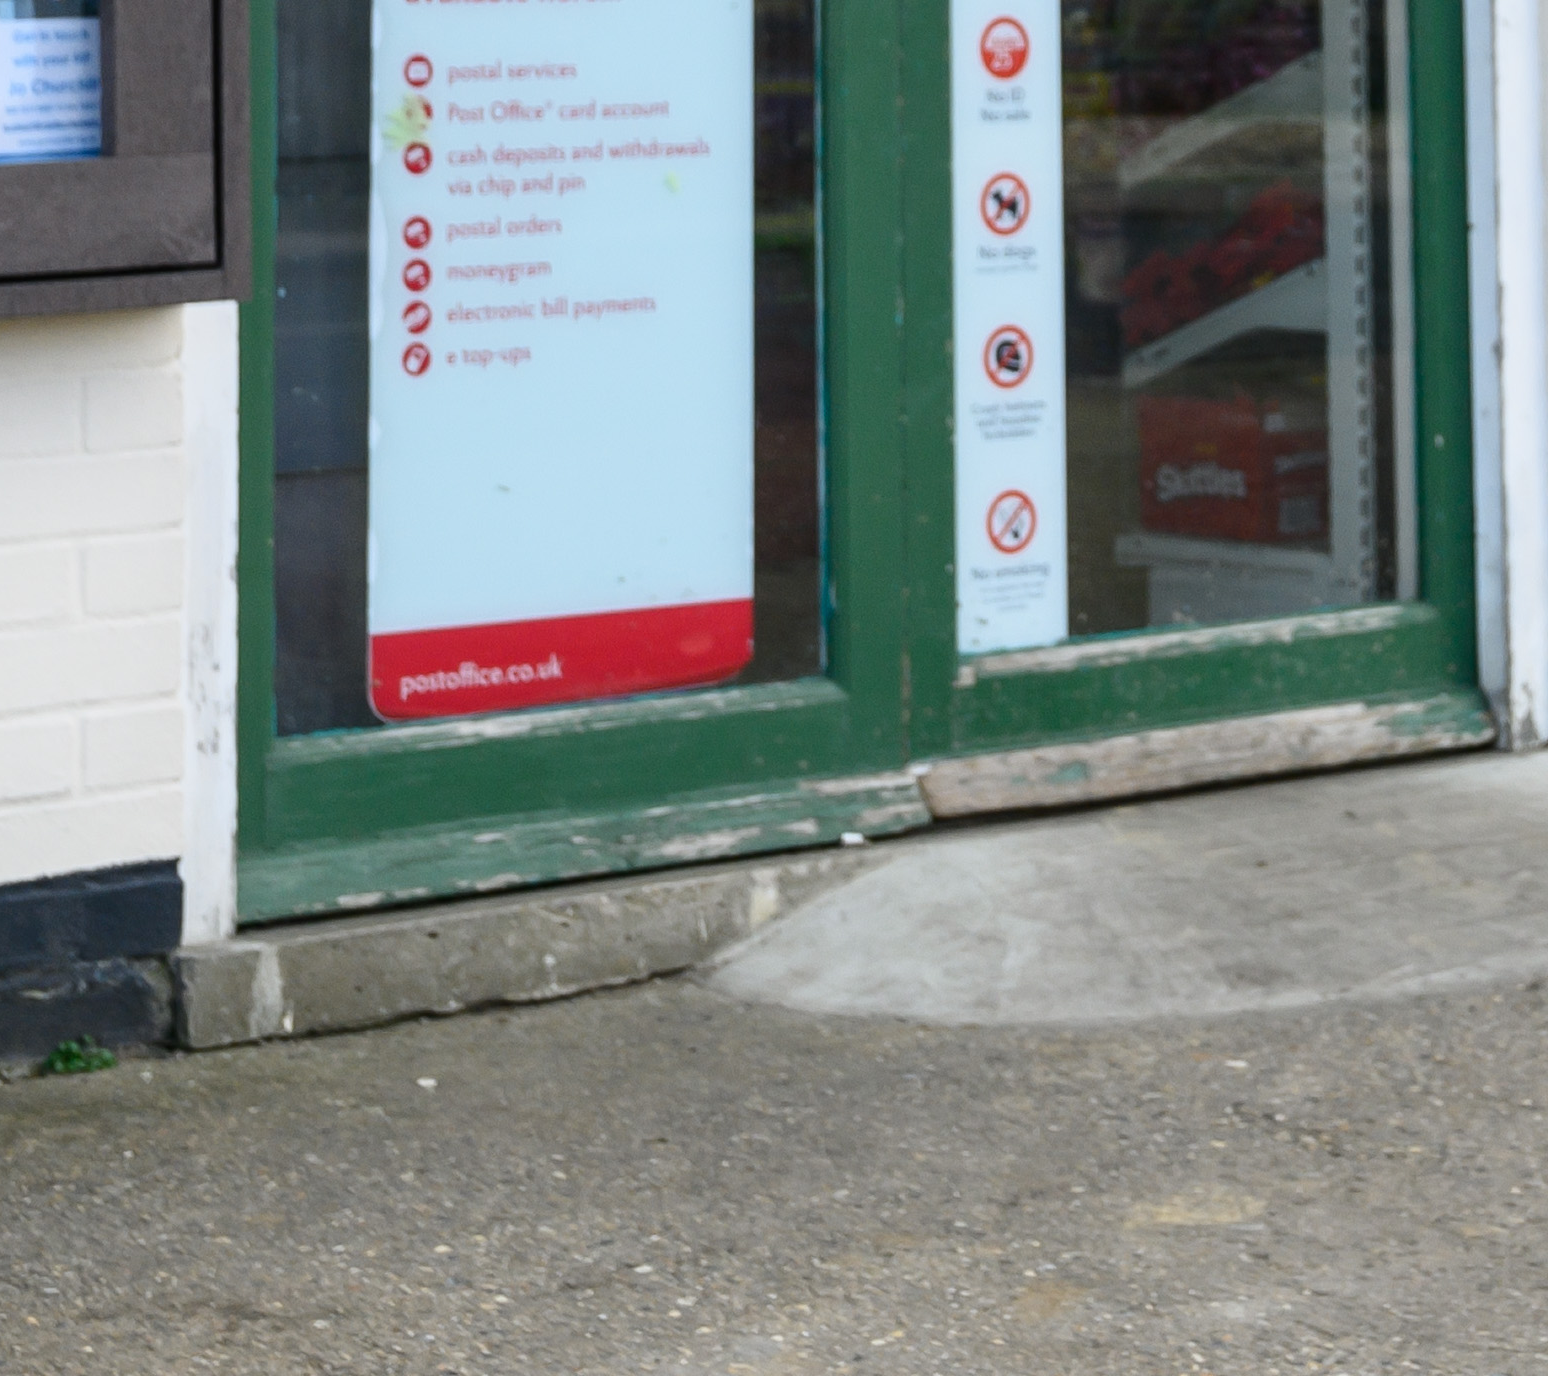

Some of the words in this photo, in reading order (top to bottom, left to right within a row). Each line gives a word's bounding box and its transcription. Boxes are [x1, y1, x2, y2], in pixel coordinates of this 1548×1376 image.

[448, 60, 502, 86] postal
[448, 102, 485, 124] Post
[559, 99, 596, 120] card
[602, 100, 670, 120] account
[572, 142, 603, 161] and
[448, 177, 472, 197] via
[479, 175, 516, 198] chip
[522, 174, 554, 193] and
[559, 173, 586, 196] pin
[447, 218, 502, 243] postal
[507, 216, 562, 236] orders
[399, 651, 564, 701] postoffice.co.uk
